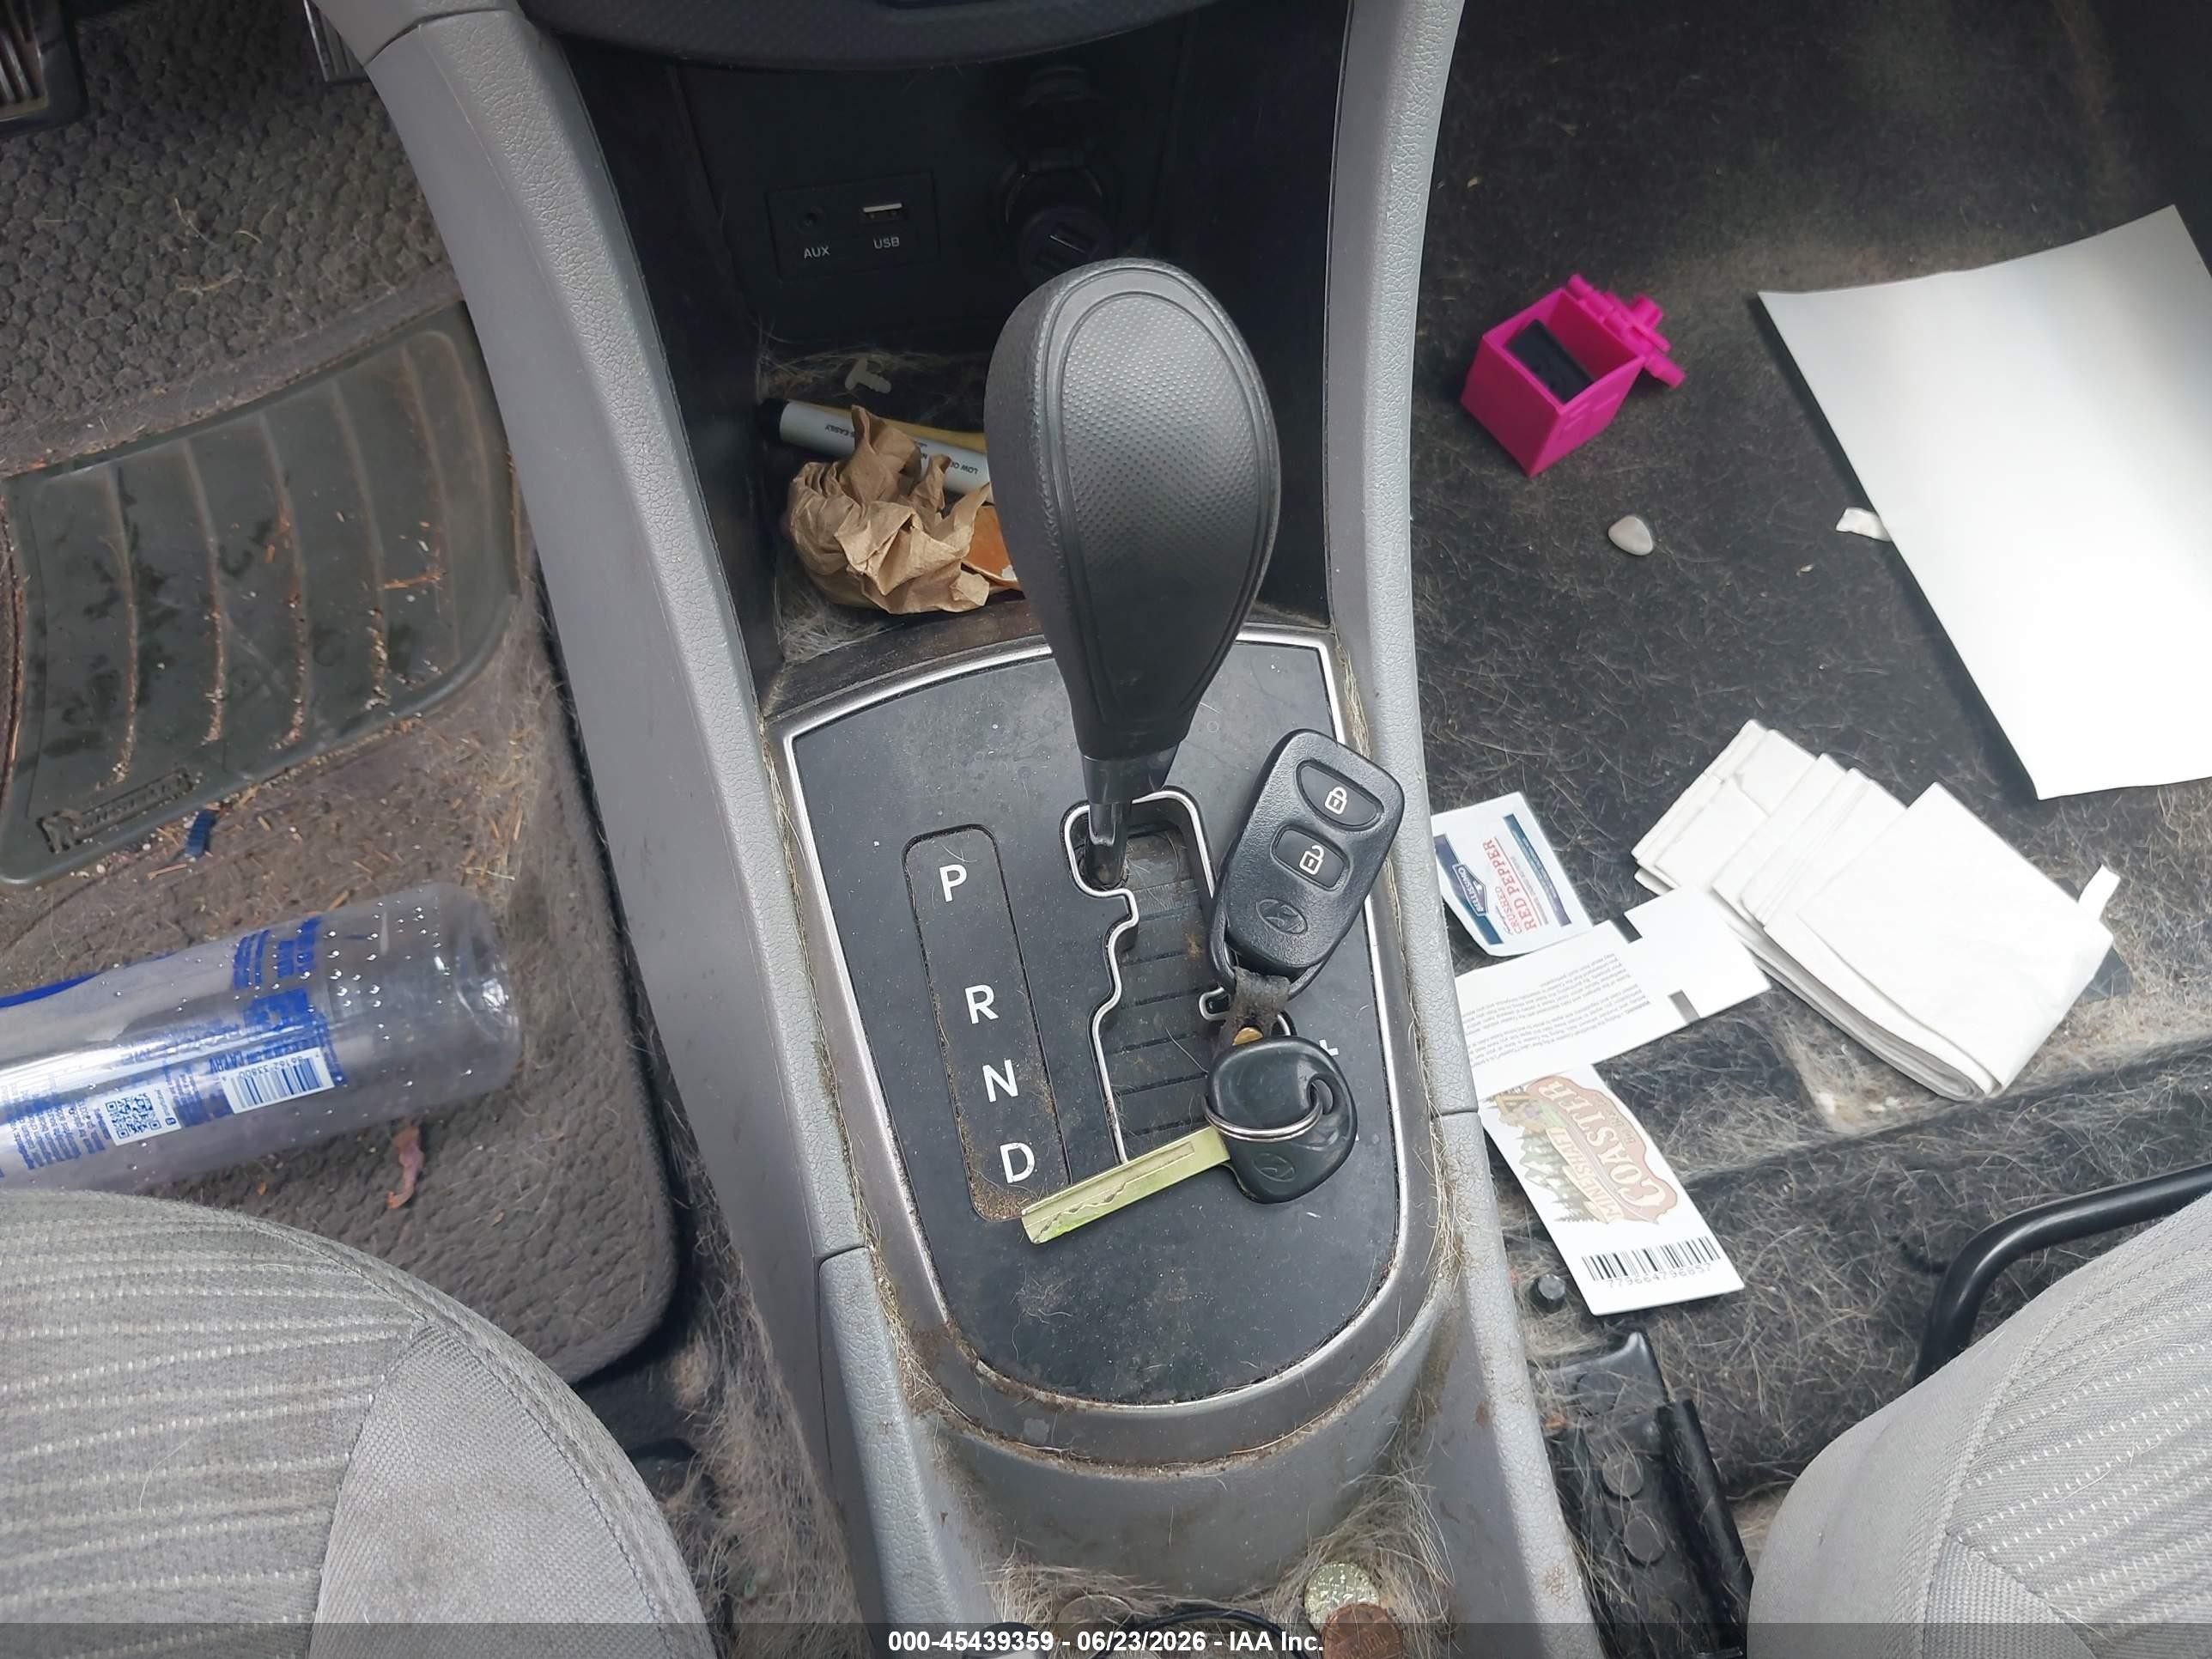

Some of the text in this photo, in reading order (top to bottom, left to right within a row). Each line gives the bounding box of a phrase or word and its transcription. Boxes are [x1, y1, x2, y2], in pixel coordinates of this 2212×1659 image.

[803, 246, 830, 258] AUX
[873, 236, 901, 249] USB
[959, 464, 980, 475] LOW
[939, 864, 967, 902] P
[1482, 839, 1520, 895] PEPPER
[1456, 866, 1485, 911] BELLISSIMO
[1494, 885, 1522, 934] CRUSHED
[1513, 898, 1538, 930] RED
[964, 984, 999, 1024] R
[982, 1059, 1018, 1103] N
[1000, 1141, 1035, 1183] D
[1538, 1080, 1666, 1206] COASTER
